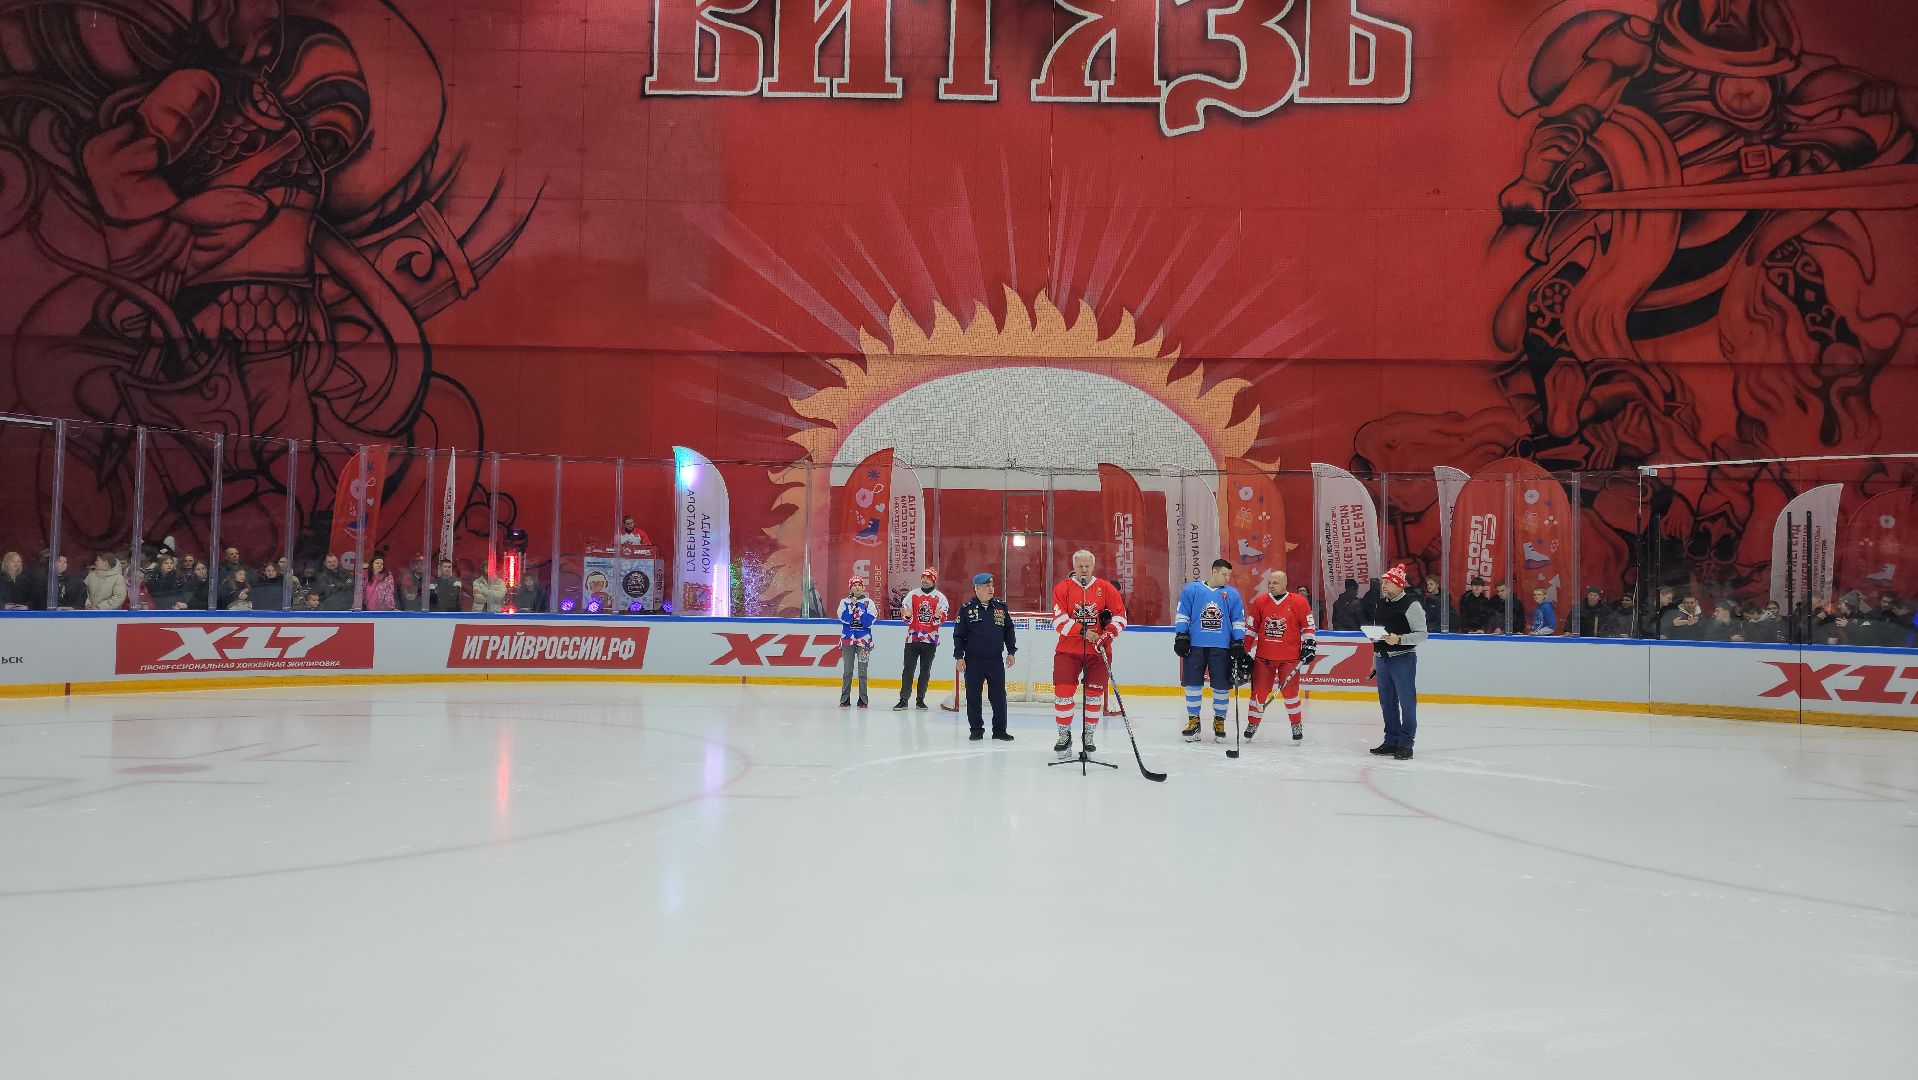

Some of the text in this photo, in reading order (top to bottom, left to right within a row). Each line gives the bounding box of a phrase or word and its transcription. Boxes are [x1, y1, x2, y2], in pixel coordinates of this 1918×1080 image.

[461, 631, 637, 661] ИГРАЙВРОССИИ.РФ
[140, 659, 341, 671] ПРОФЕССИОНАЛЬНАЯ ХОККЕЙНАЯ ЭКИПИРОВКА
